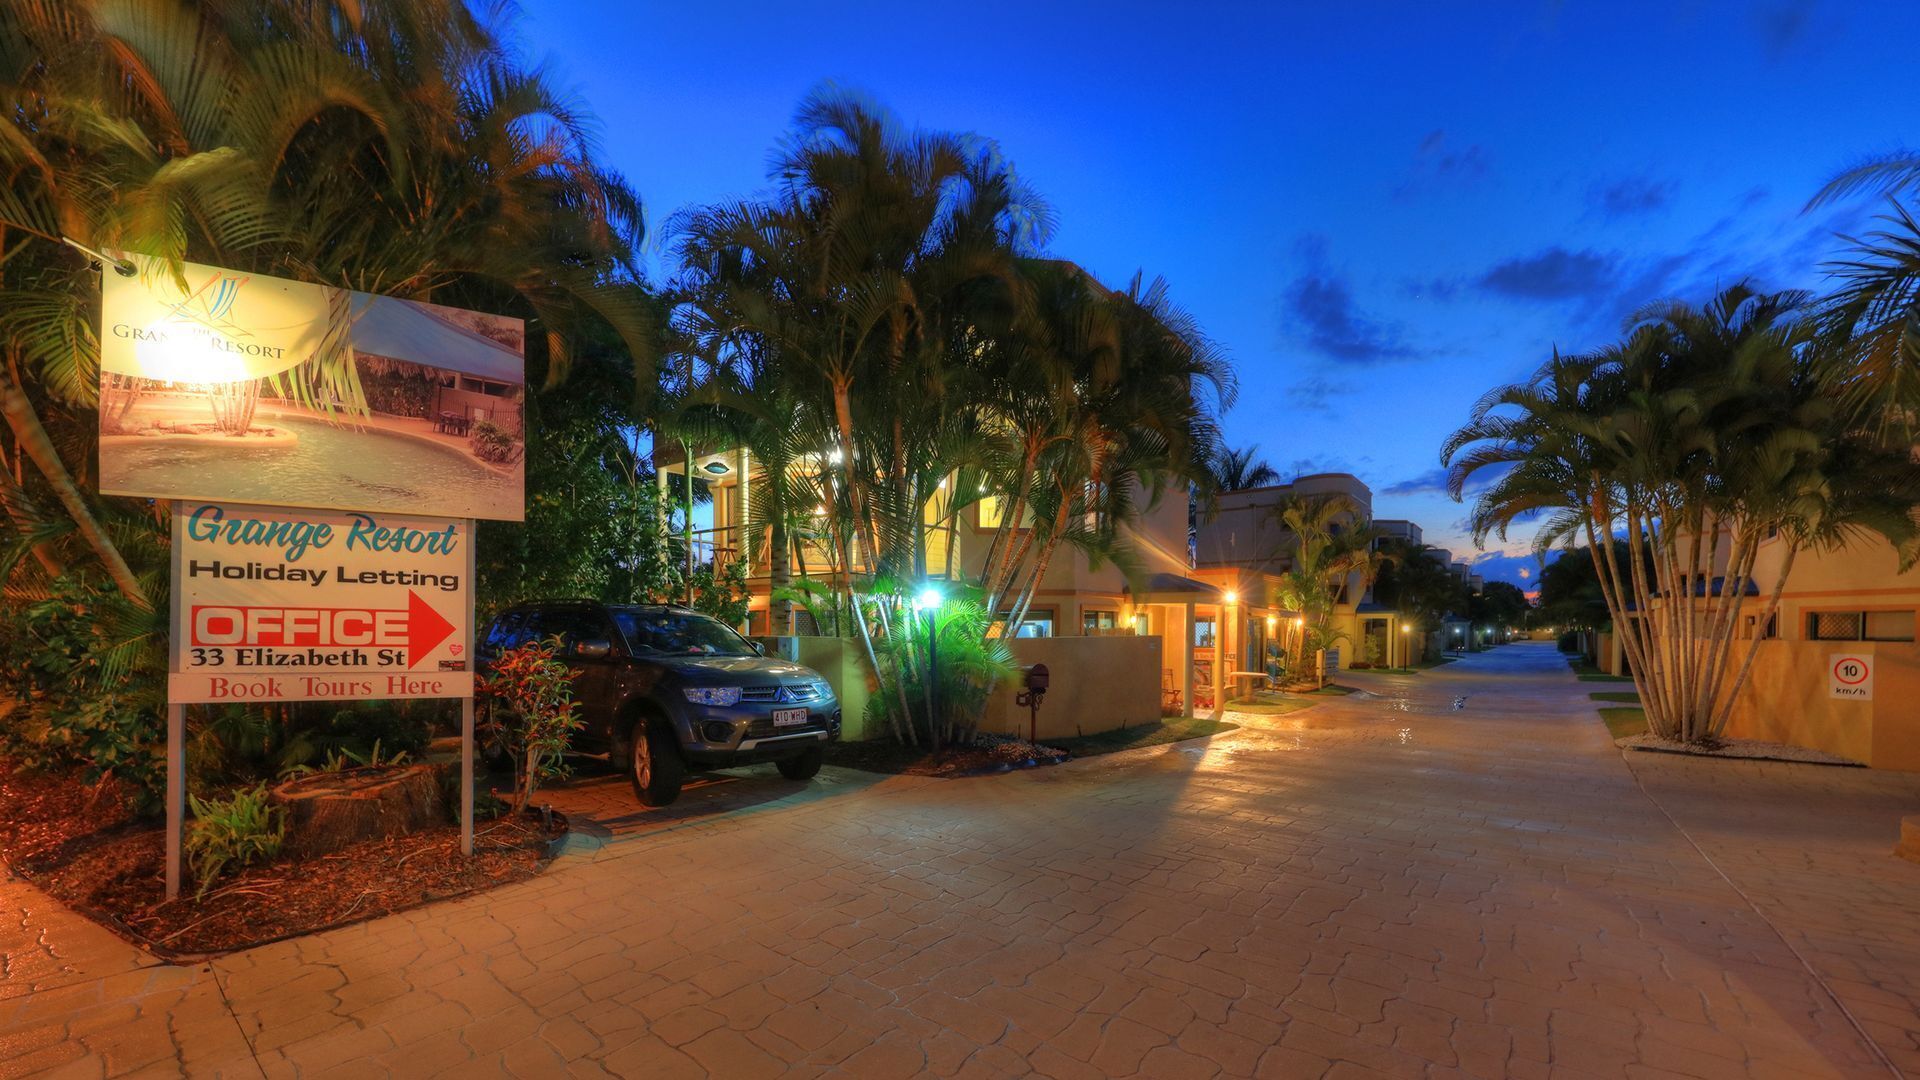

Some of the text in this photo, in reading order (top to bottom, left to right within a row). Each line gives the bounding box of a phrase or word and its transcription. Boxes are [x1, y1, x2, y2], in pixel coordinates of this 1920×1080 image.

[112, 323, 286, 359] GRAN RESORT
[187, 504, 458, 562] Grange Resort
[189, 559, 459, 592] Holiday Letting
[195, 607, 409, 645] OFFICE
[190, 648, 406, 667] 33 Elizabeth St
[1843, 665, 1858, 677] 10
[208, 675, 443, 698] Book Tours Here
[1835, 687, 1866, 695] km/h
